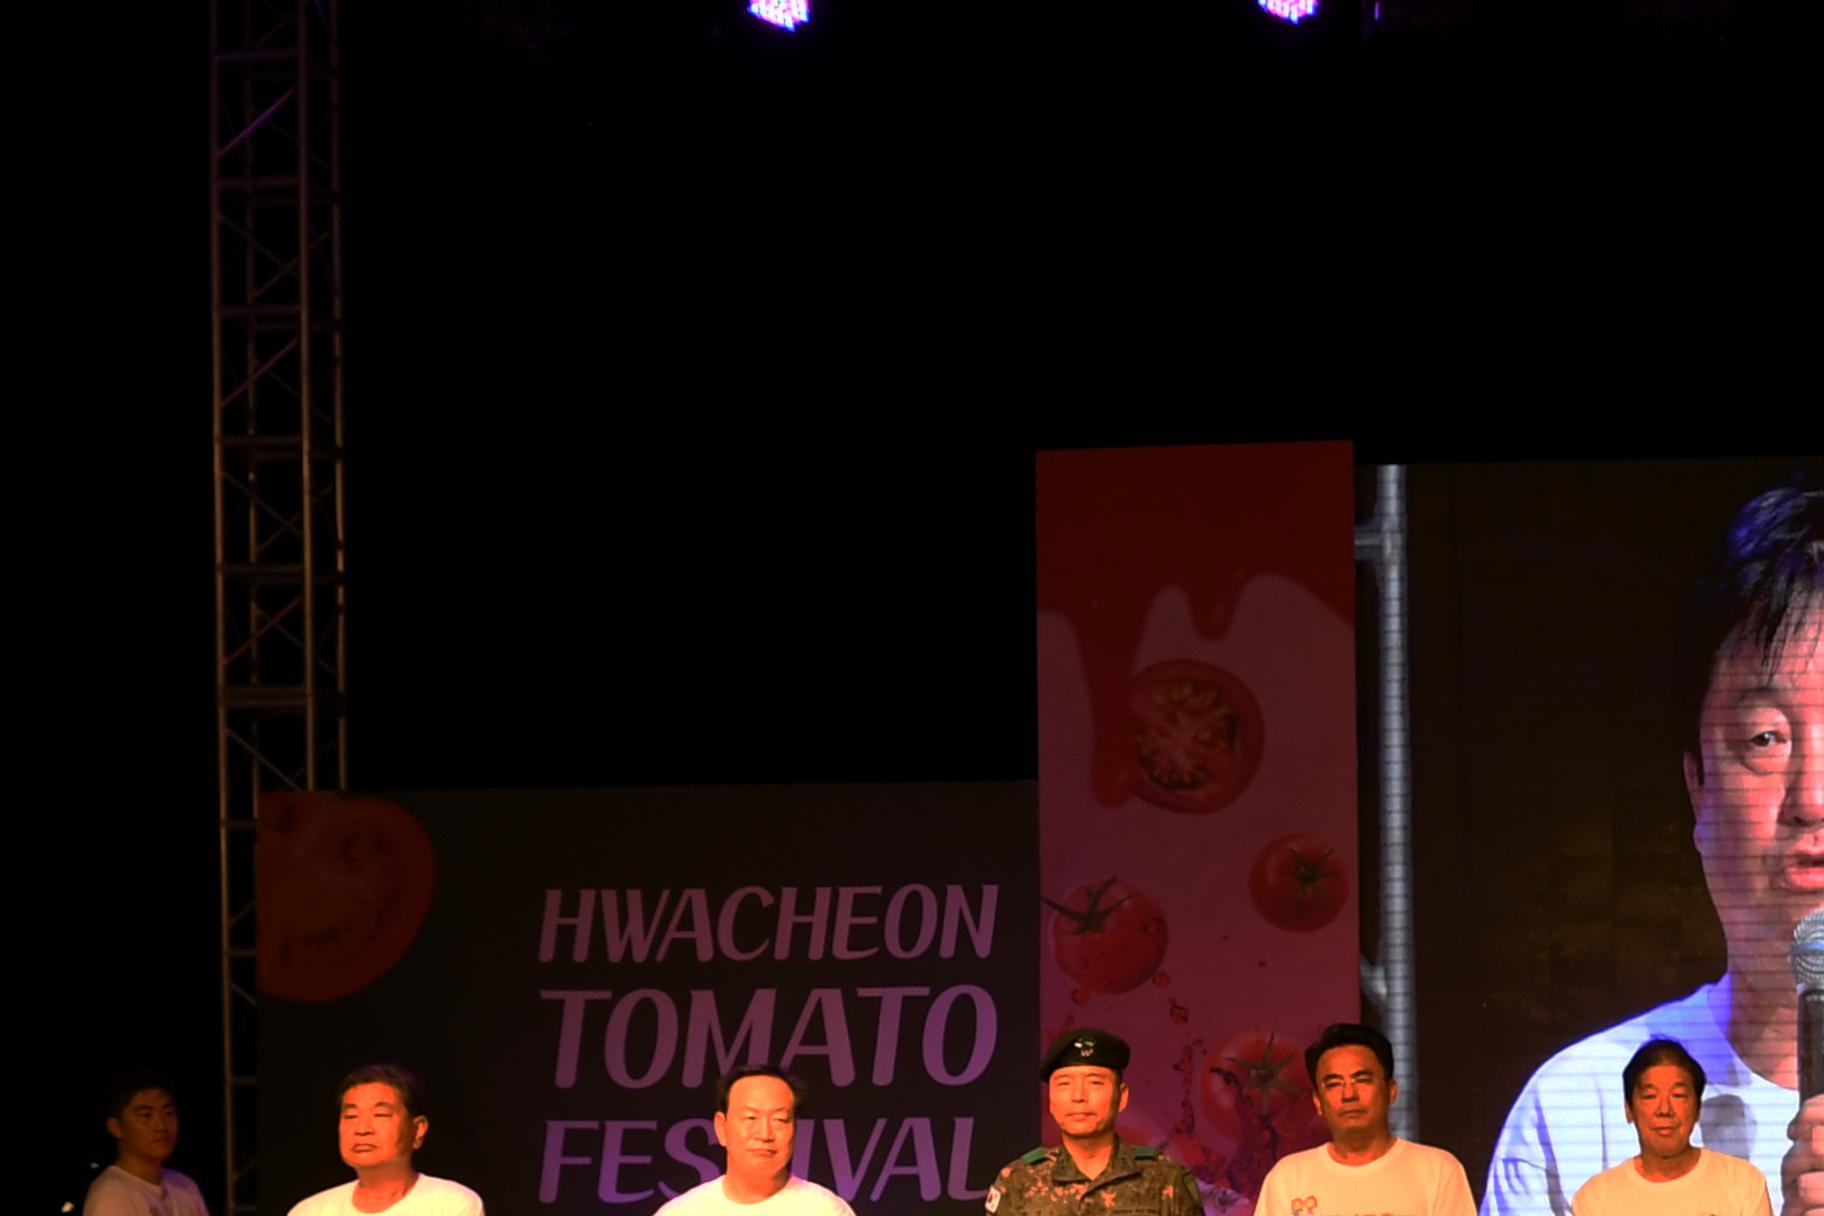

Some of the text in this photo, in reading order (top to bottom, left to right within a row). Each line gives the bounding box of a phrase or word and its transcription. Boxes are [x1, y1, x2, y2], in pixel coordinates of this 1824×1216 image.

[538, 883, 999, 964] HWACHEON
[539, 984, 998, 1089] TOMATO
[538, 1116, 990, 1205] FESIVAL
